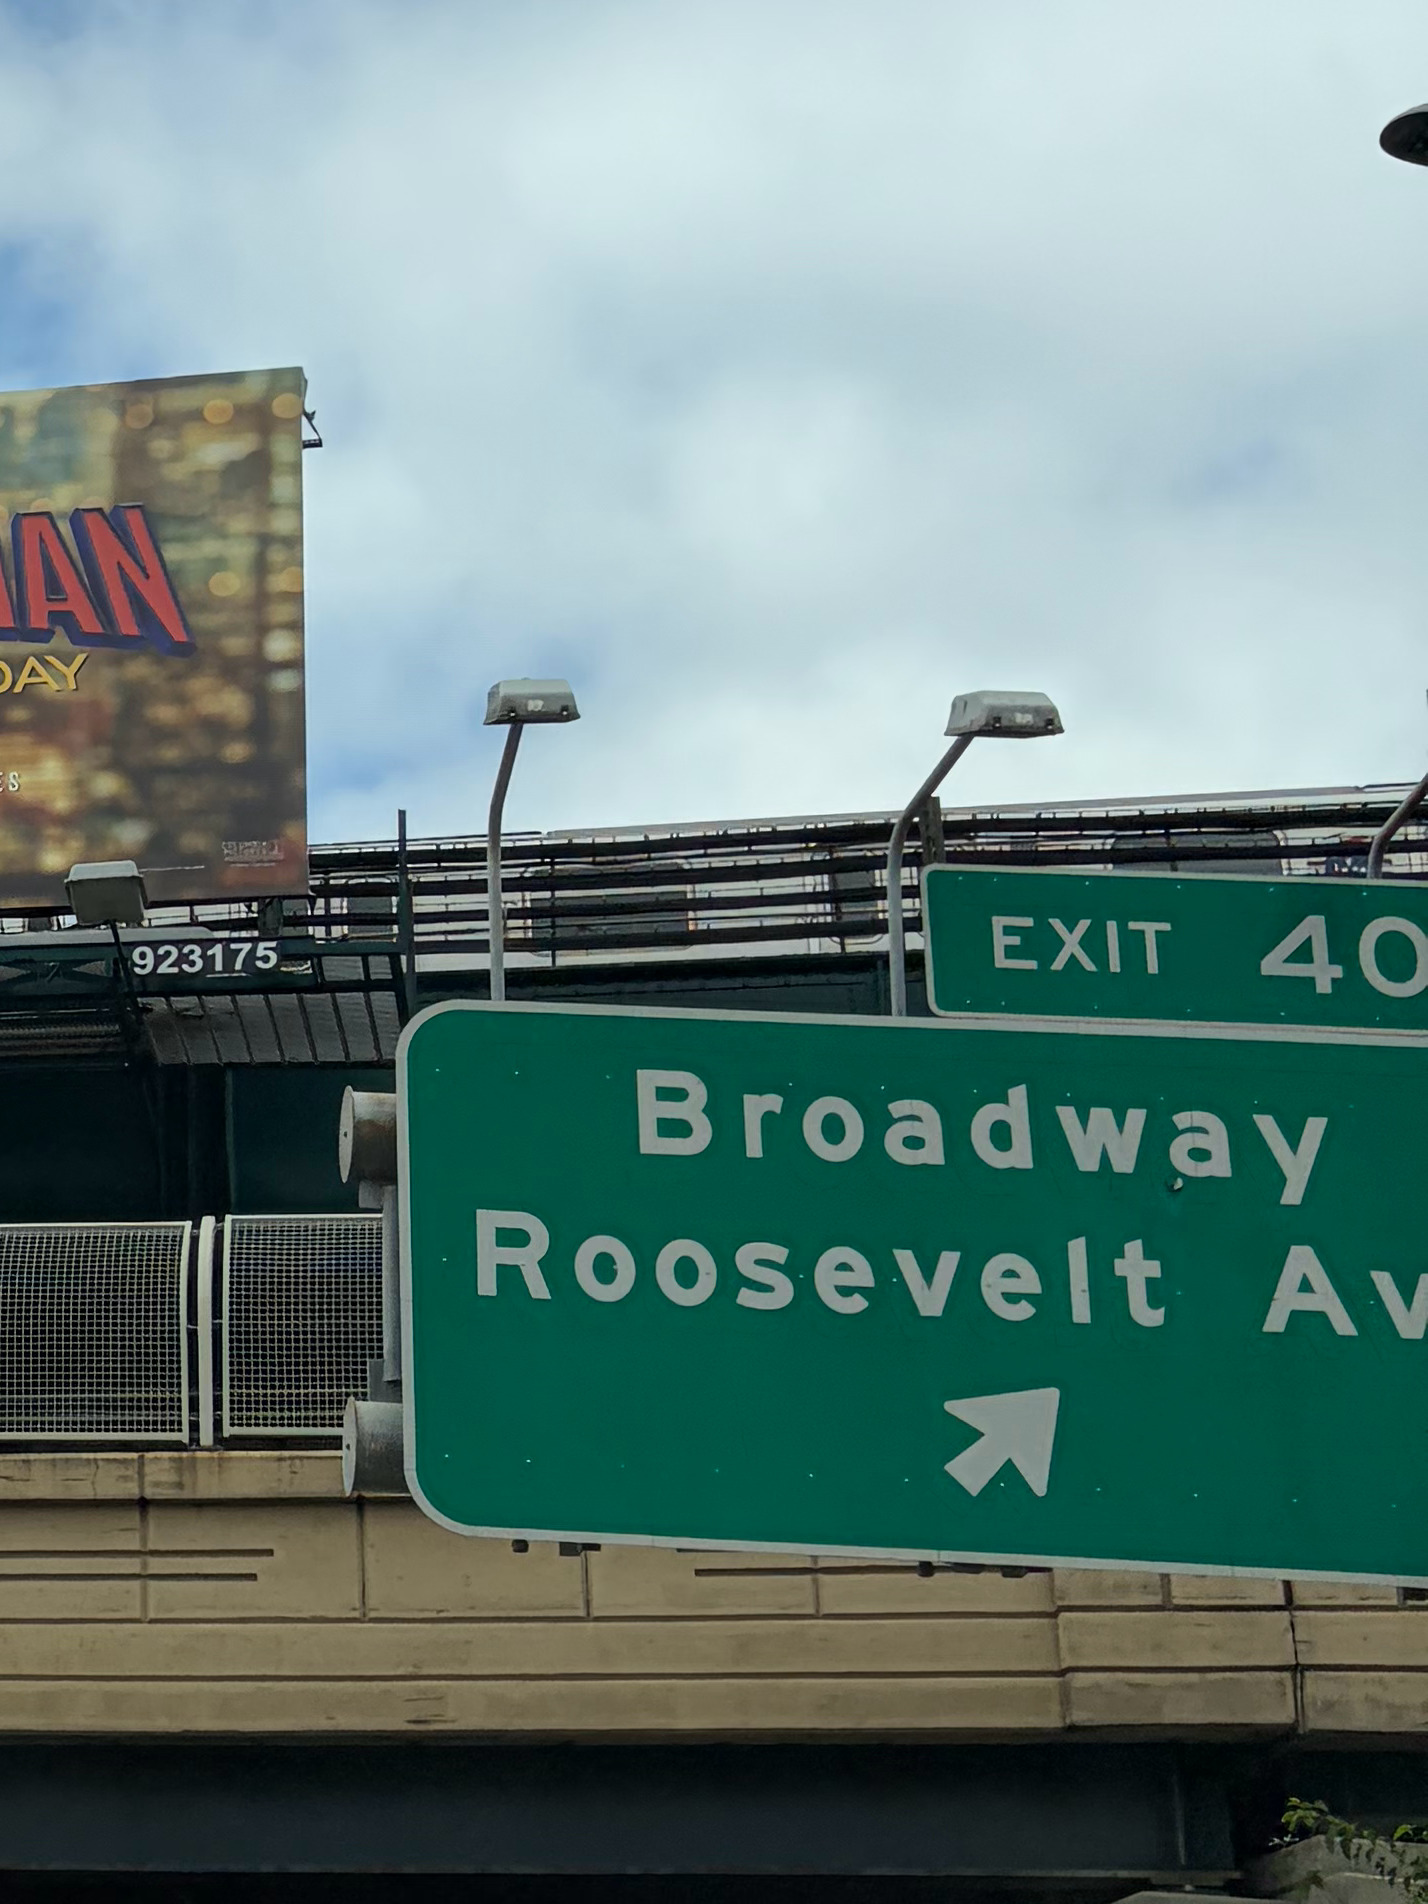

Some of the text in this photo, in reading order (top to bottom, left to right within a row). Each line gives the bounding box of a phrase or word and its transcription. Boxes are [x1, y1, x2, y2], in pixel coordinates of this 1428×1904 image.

[131, 941, 279, 976] 923175
[990, 914, 1428, 999] EXIT 40
[635, 1068, 1329, 1206] Broadway
[474, 1208, 1428, 1341] Roosevelt Av
